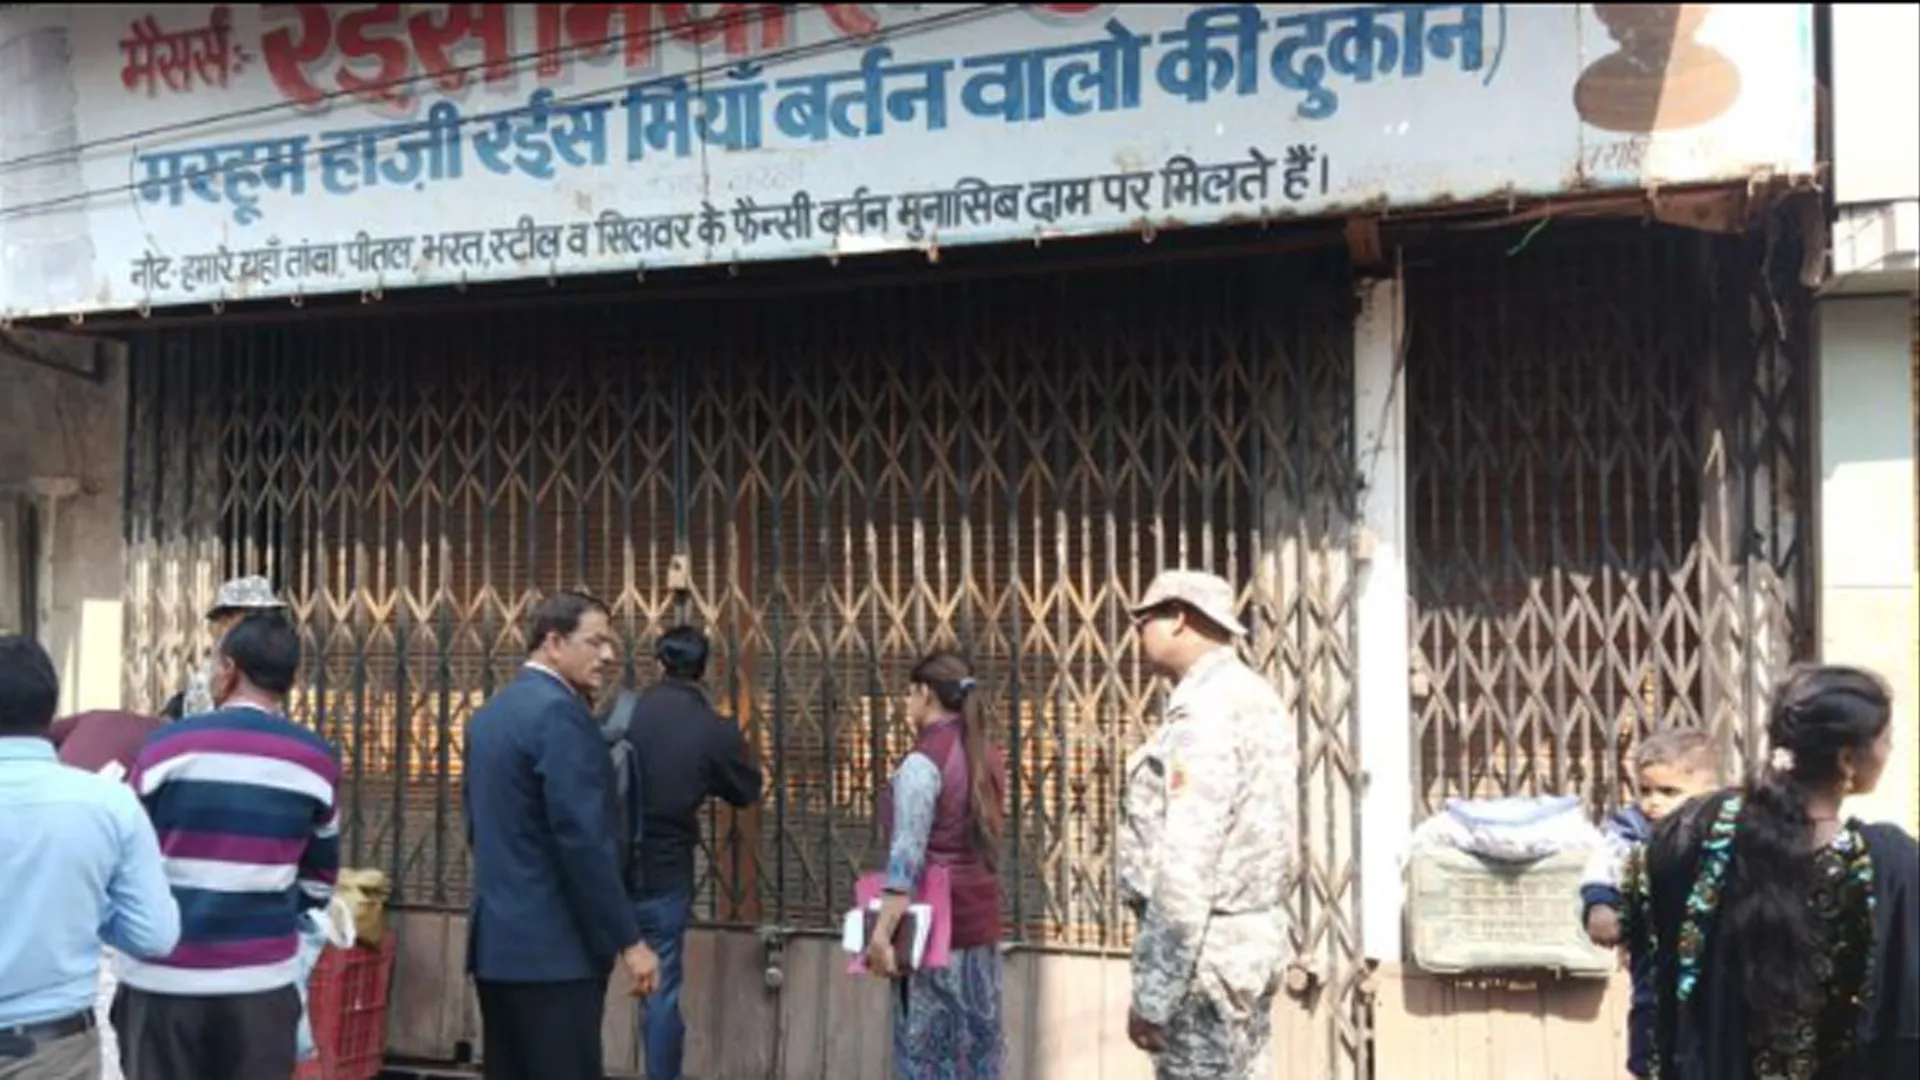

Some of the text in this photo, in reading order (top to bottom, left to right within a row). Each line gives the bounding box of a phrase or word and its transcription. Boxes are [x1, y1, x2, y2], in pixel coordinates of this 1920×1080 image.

[474, 88, 614, 180] रईस
[622, 61, 767, 162] मियाँ
[776, 46, 954, 141] बर्तन
[961, 17, 1153, 122] वालो
[1156, 4, 1269, 102] की
[567, 223, 589, 257] व
[595, 209, 694, 255] सिलवर
[699, 199, 726, 247] के
[817, 185, 892, 235] बर्तन
[897, 176, 1023, 241] मुनासिब
[1025, 176, 1096, 222] दाम
[1095, 170, 1155, 213] पर
[1159, 146, 1276, 210] मिलते
